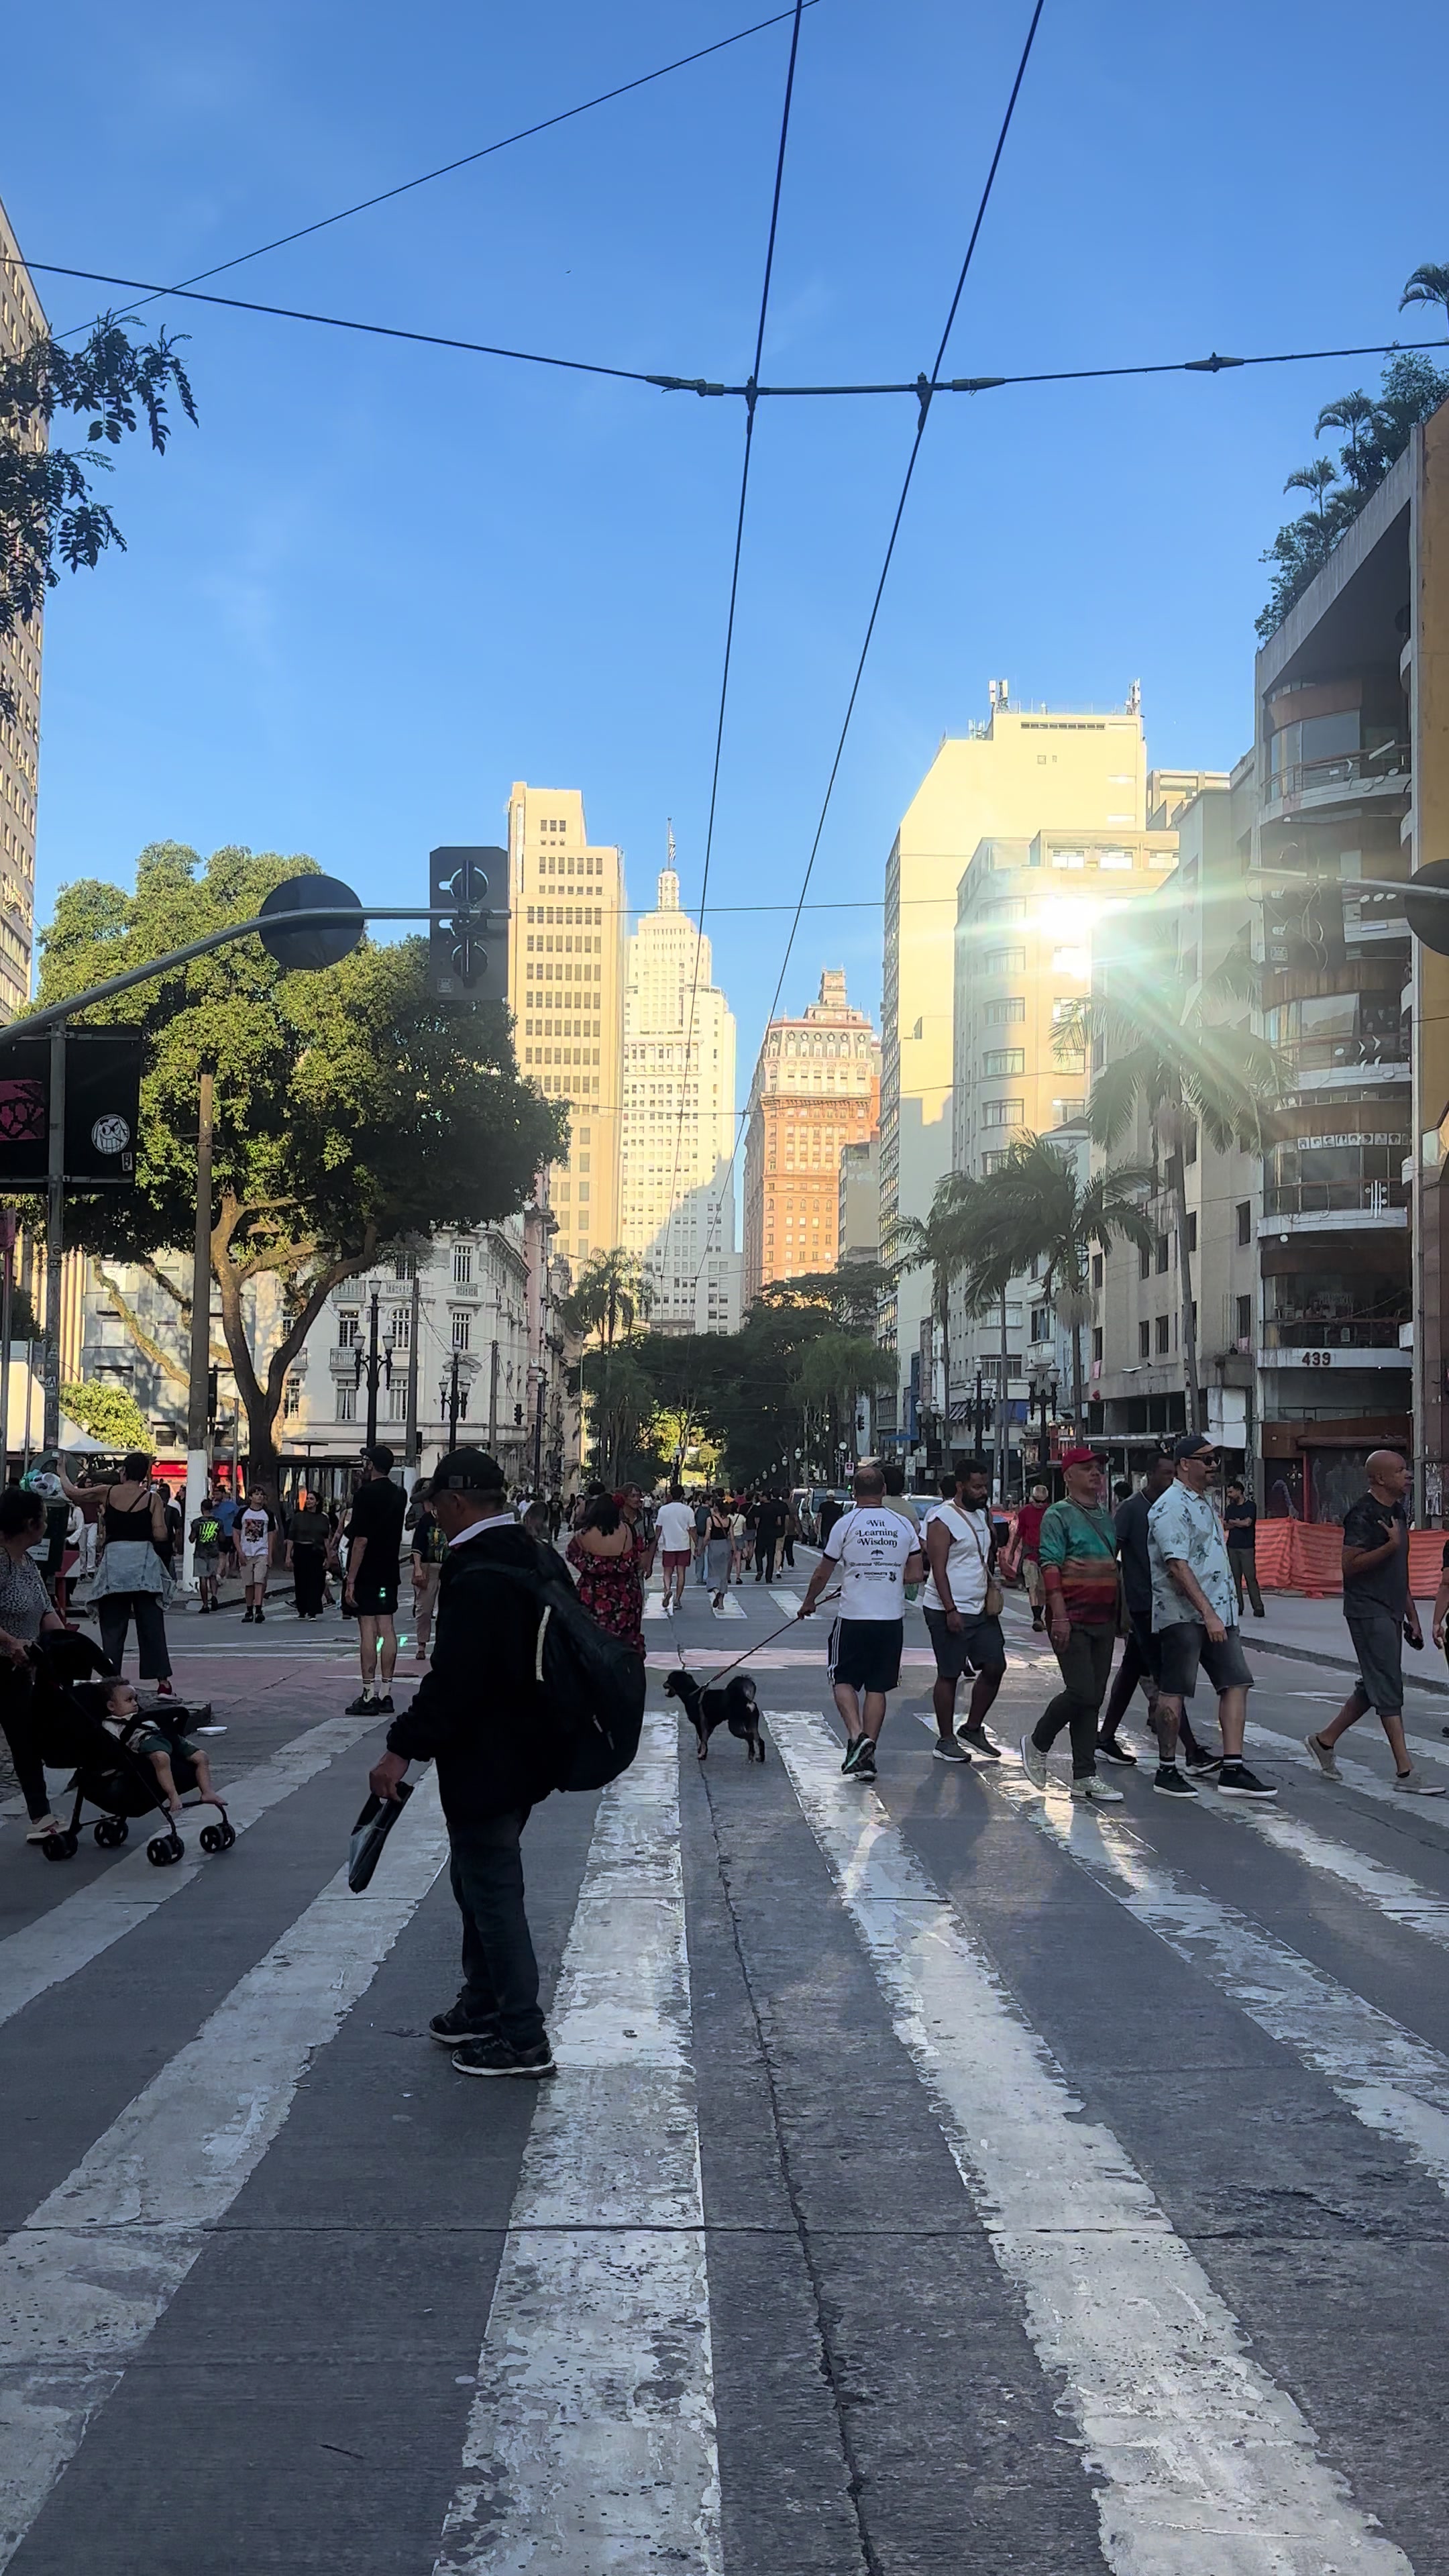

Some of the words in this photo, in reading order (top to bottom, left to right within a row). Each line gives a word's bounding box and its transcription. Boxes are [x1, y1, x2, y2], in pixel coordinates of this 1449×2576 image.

[1301, 1351, 1331, 1366] 439
[855, 1529, 898, 1538] Learning
[857, 1538, 898, 1548] Wisdom
